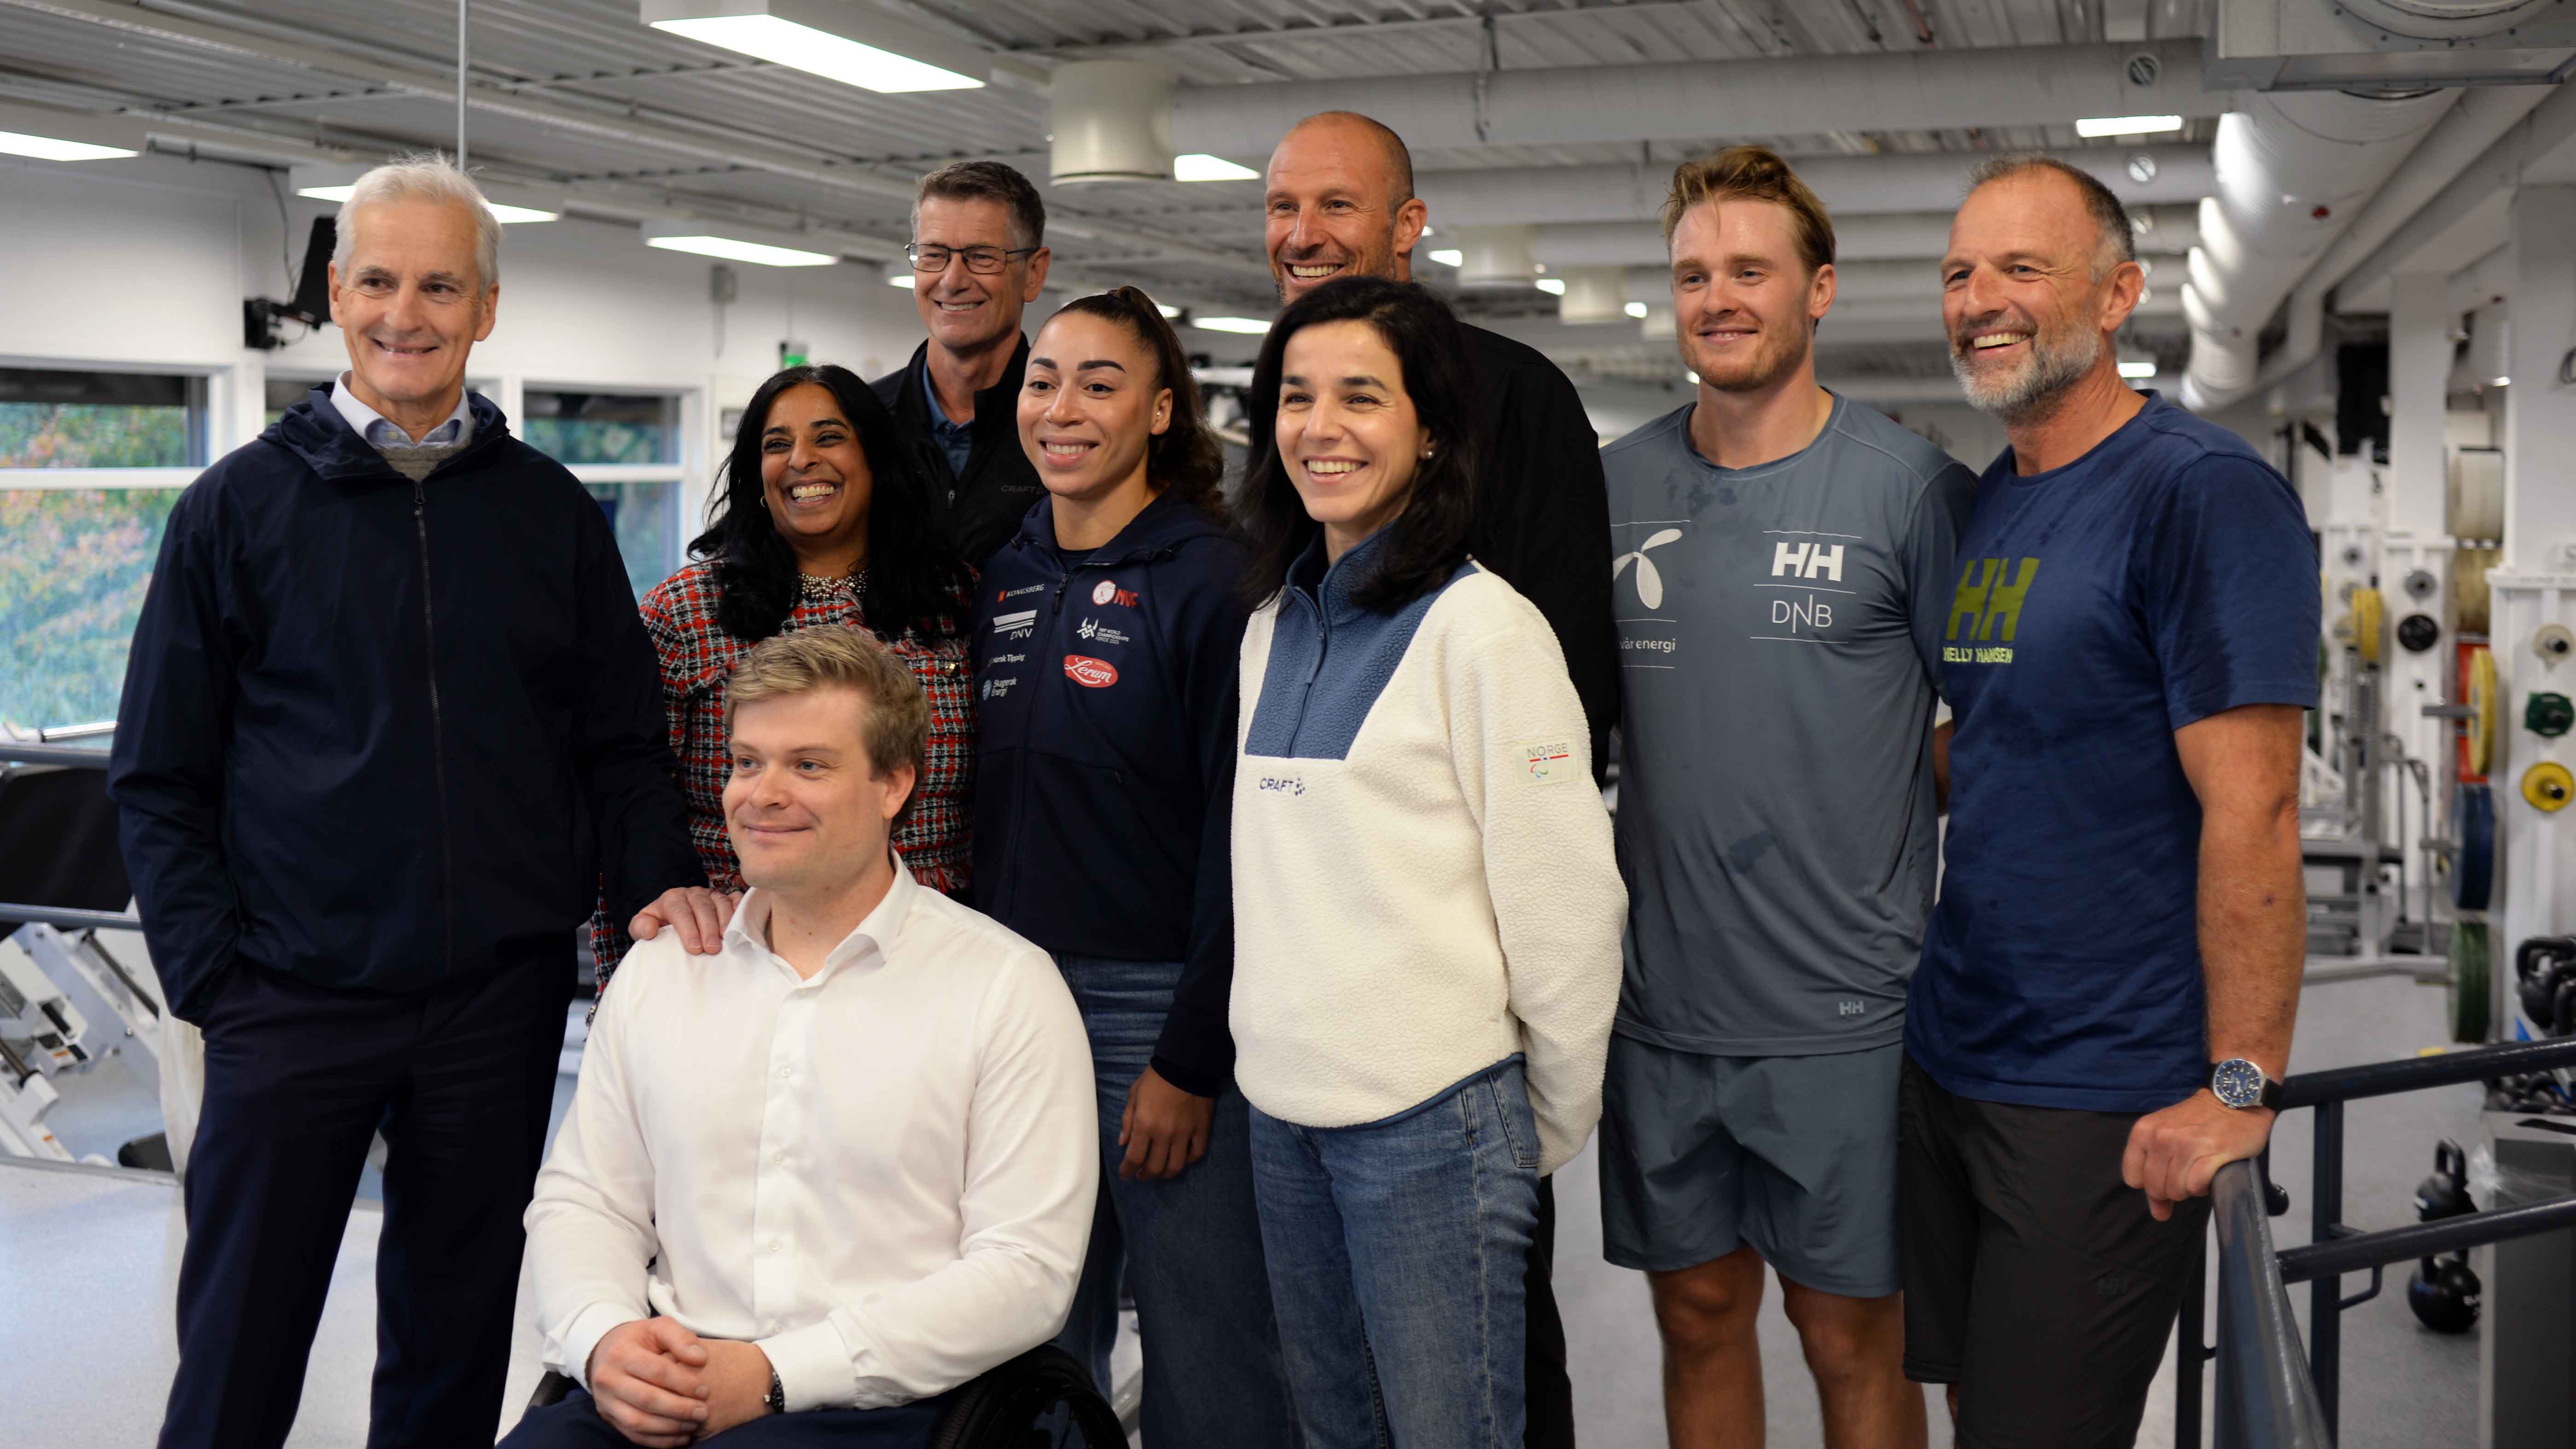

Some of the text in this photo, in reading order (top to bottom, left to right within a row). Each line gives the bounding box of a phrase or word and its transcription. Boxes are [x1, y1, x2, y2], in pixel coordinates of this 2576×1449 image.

[1771, 542, 1845, 582] HH
[1006, 584, 1044, 598] KONGSBERG
[1945, 557, 2040, 641] HH
[1772, 594, 1832, 633] DNB
[1010, 628, 1033, 640] DNV
[1975, 647, 2013, 663] HANSEN
[1064, 657, 1112, 684] Lerum
[1527, 742, 1569, 757] NORGE
[1260, 777, 1294, 792] CRAFT
[1839, 1000, 1864, 1015] HH
